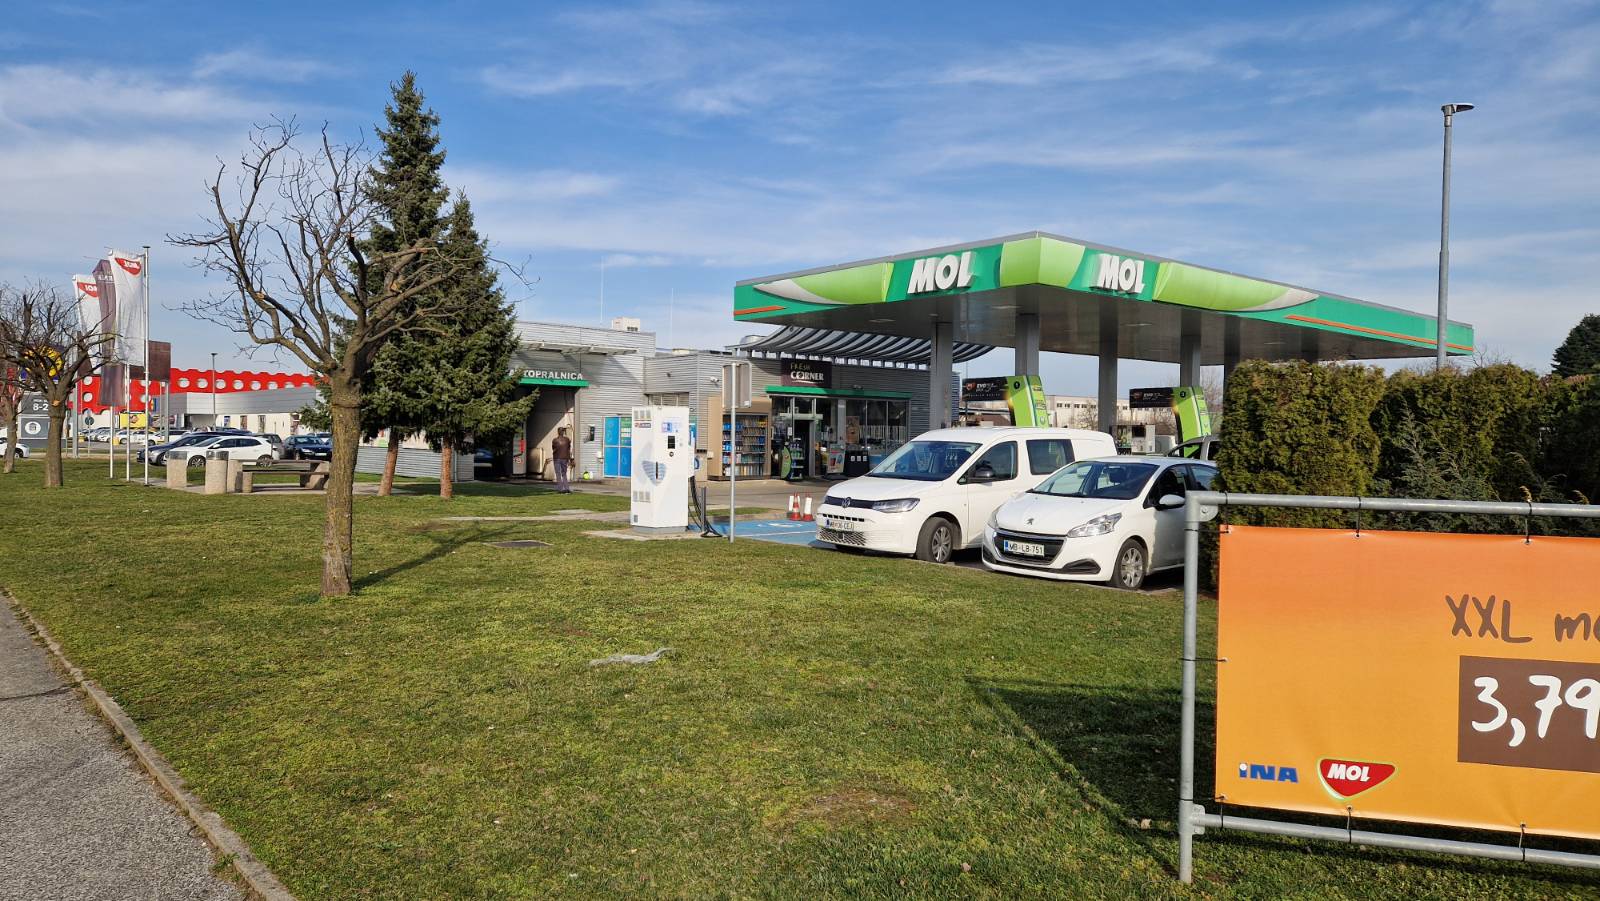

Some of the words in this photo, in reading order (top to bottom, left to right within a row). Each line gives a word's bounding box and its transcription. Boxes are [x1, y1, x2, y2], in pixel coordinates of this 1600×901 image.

[907, 251, 974, 295] MOL
[1094, 253, 1146, 294] MOL
[508, 369, 583, 381] ATOPRALNICA
[790, 371, 824, 381] CORNER
[1444, 594, 1534, 644] XXL
[1326, 763, 1371, 783] MOL
